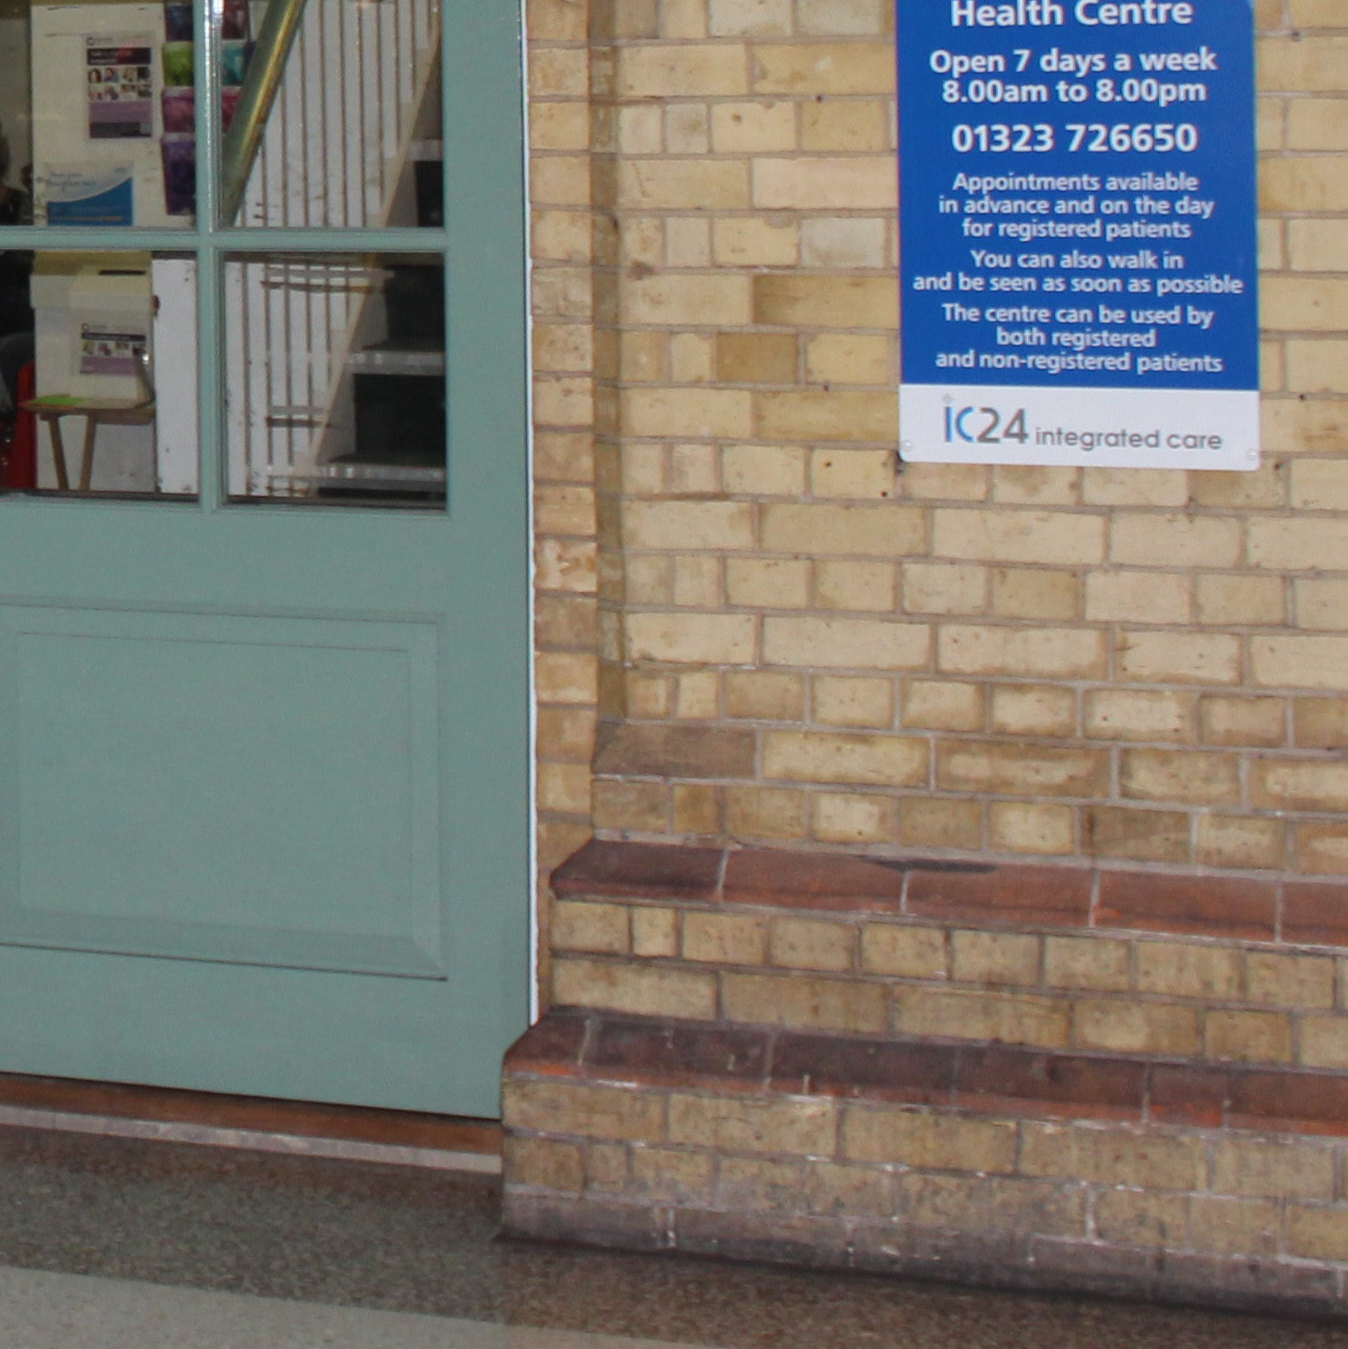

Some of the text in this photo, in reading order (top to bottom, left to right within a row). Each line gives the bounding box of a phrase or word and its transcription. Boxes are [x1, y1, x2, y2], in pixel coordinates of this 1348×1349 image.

[930, 45, 1218, 77] Open 7 days a week
[943, 78, 1208, 105] 8.00am to 8.00pm
[952, 123, 1199, 152] 01323 726650
[952, 171, 1200, 194] Appointments available
[939, 194, 1215, 219] in advance and on the day
[962, 217, 1193, 242] for registered patients
[970, 249, 1185, 269] You can also walk in
[913, 271, 1244, 296] and be seen as soon as possible
[941, 302, 1215, 328] The centre can be used by
[996, 326, 1157, 350] both registered
[936, 349, 1224, 375] and non-registered patients
[1035, 427, 1223, 452] integrated care
